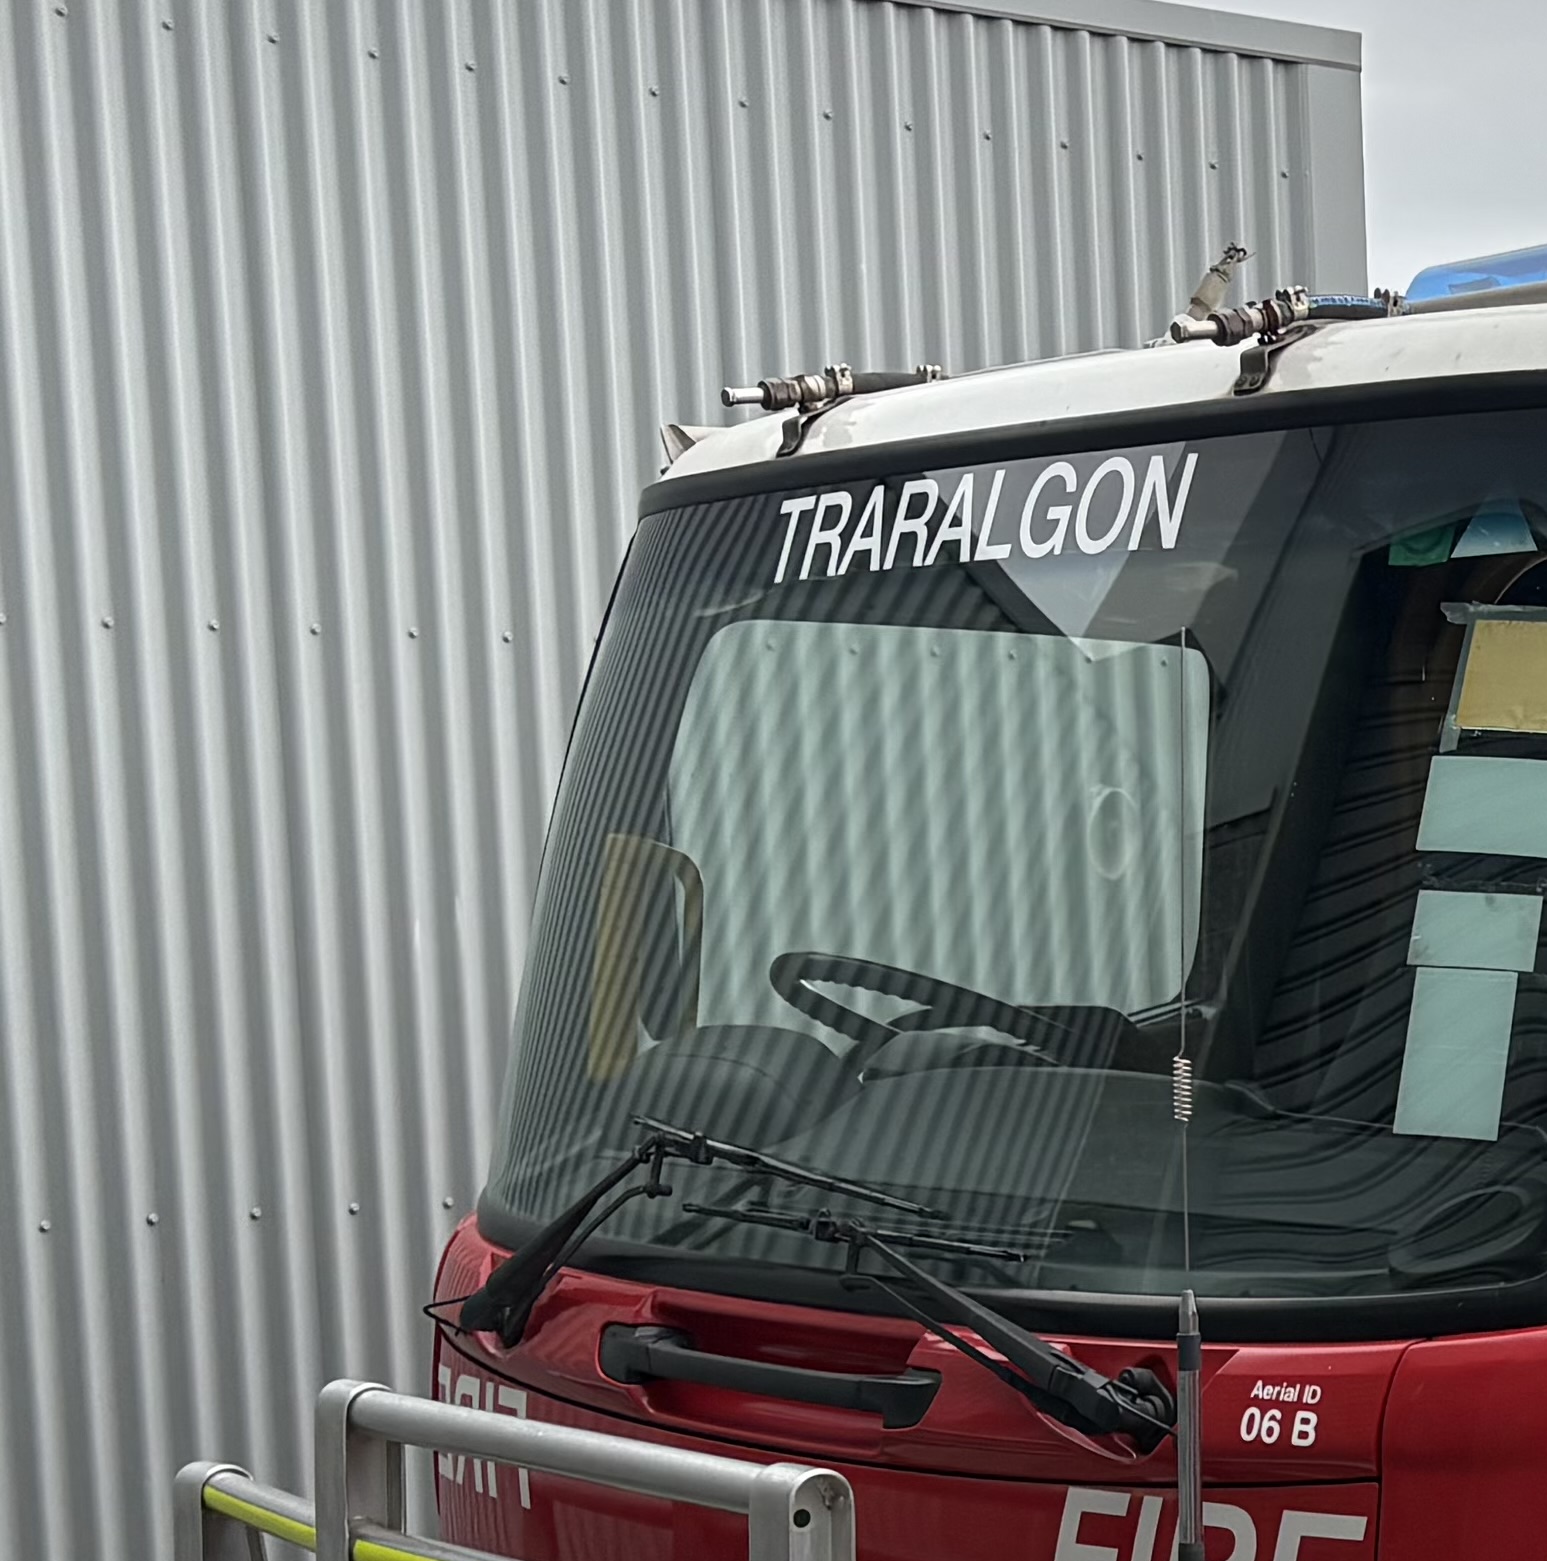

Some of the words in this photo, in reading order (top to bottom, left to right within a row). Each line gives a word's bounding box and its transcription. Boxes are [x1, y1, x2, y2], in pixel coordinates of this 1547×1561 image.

[774, 452, 1198, 584] TRARALGON
[1250, 1379, 1300, 1403] Aerial
[1303, 1384, 1322, 1405] ID
[1239, 1406, 1282, 1445] 06
[1291, 1410, 1318, 1447] B
